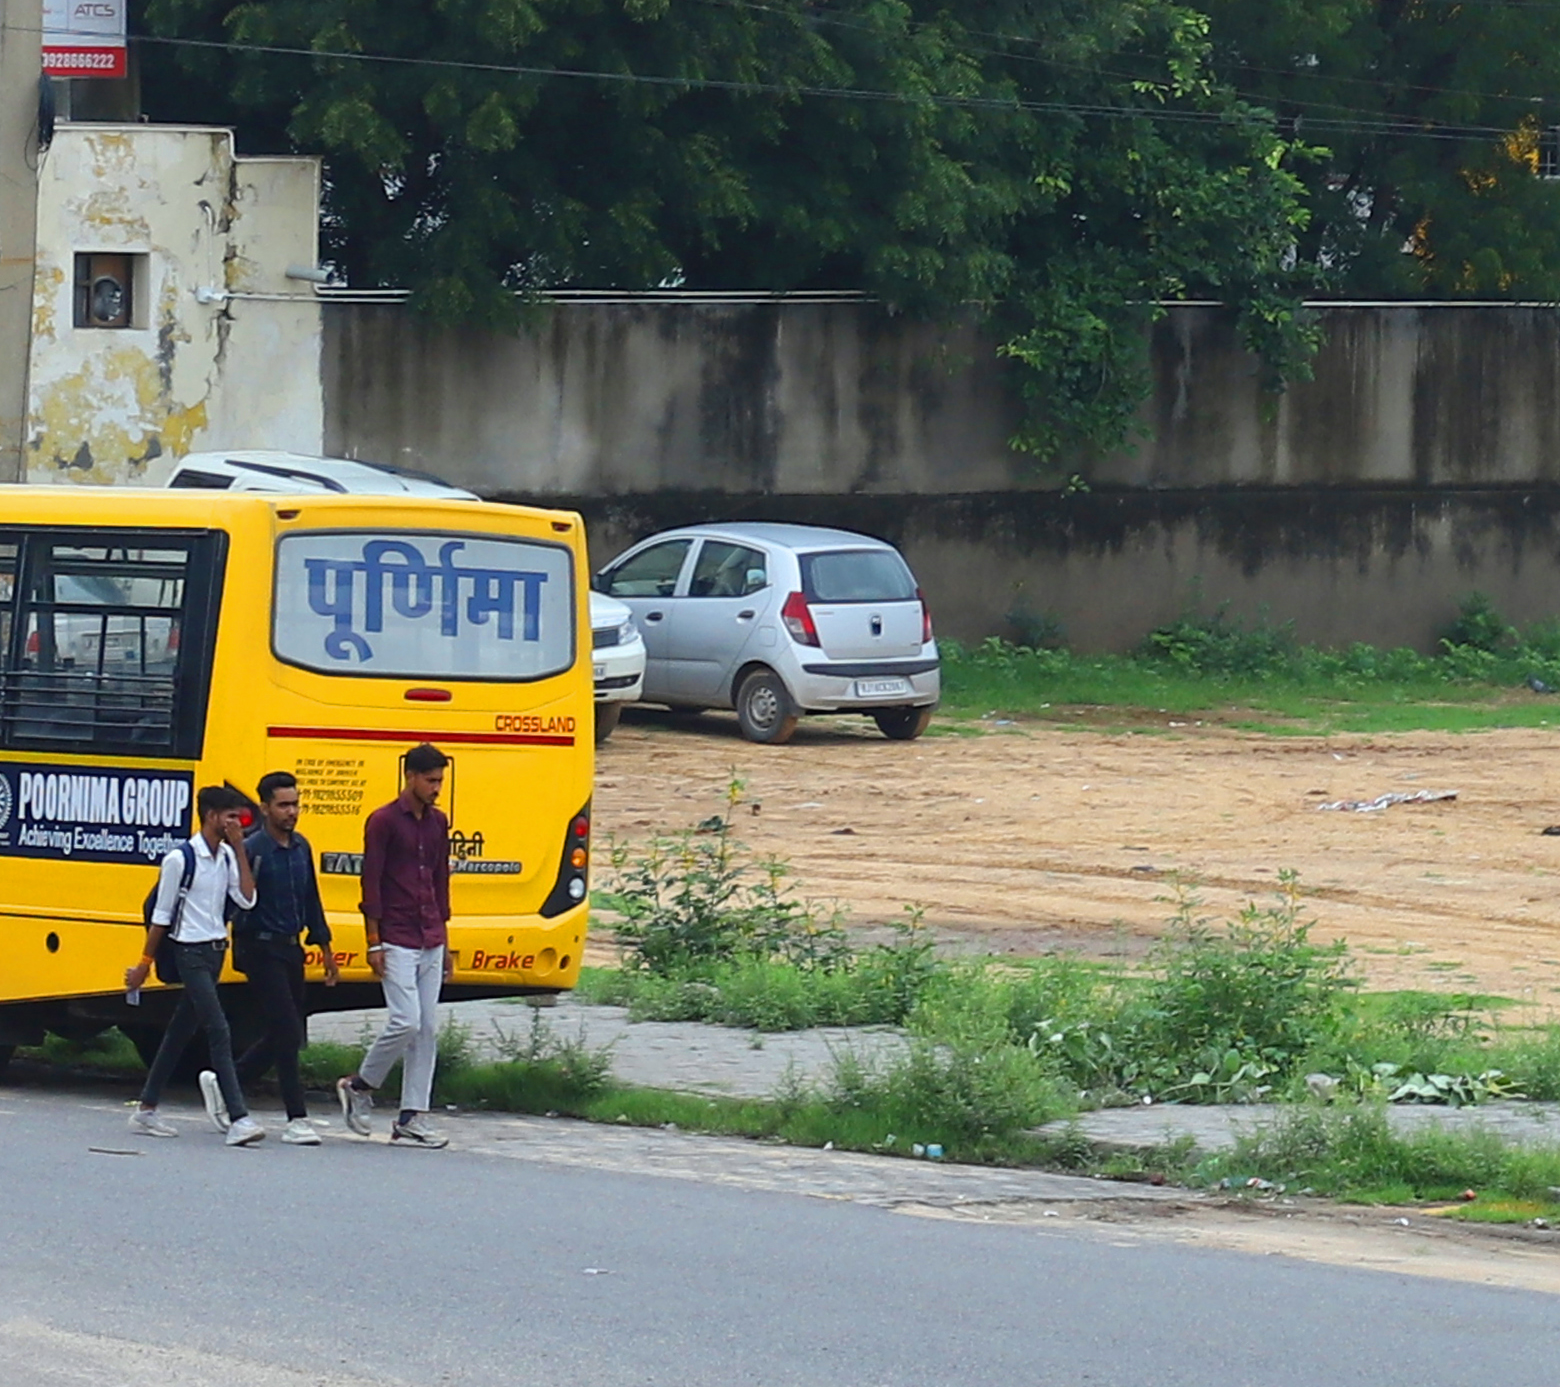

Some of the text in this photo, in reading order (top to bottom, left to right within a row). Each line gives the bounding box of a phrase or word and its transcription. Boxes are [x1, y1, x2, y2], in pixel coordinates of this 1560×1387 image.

[74, 3, 116, 17] ATCS
[304, 539, 549, 663] पूर्णिमा
[495, 715, 576, 733] CROSSLAND
[18, 772, 190, 828] POORNIMA GROUP
[18, 823, 73, 856] Achieving
[73, 827, 134, 853] Excellence
[458, 859, 521, 873] Marcopolo
[472, 950, 534, 969] Brake
